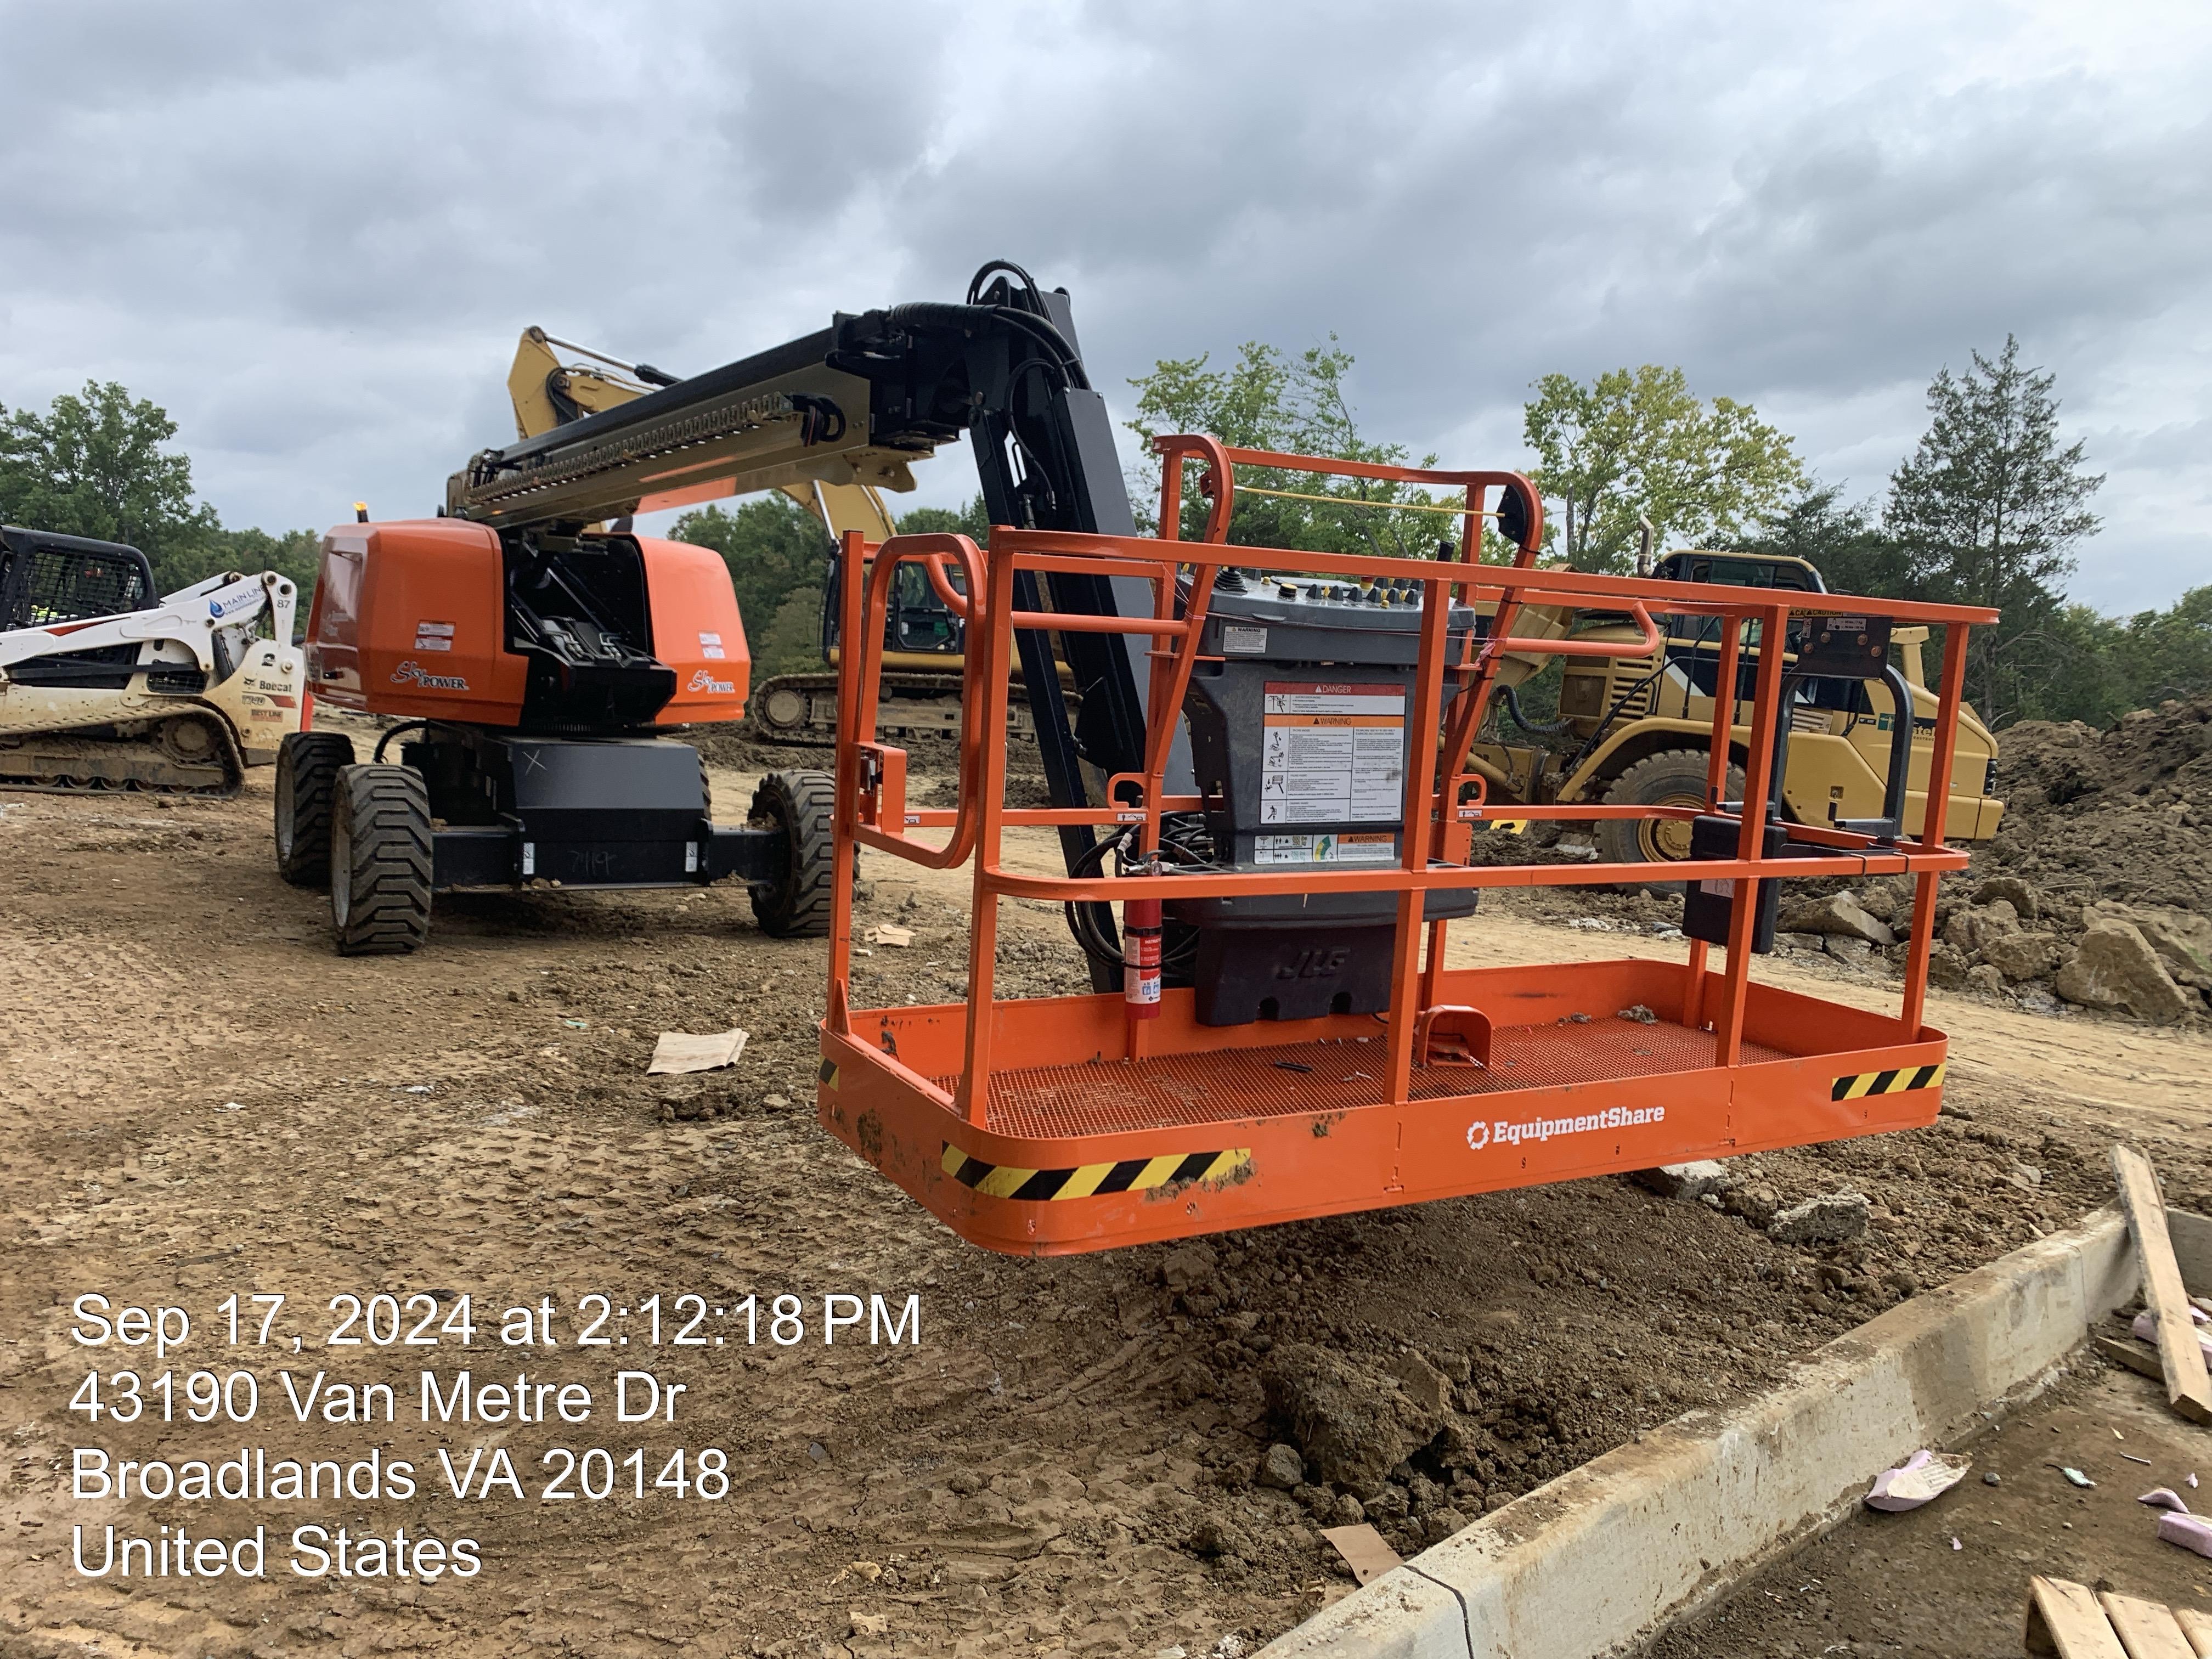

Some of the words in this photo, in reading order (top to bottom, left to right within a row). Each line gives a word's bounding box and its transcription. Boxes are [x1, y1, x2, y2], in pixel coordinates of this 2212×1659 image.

[222, 592, 246, 608] MAIN
[276, 600, 290, 608] 87
[259, 680, 292, 692] Bobcat
[1323, 685, 1352, 693] DANGER
[1912, 725, 1936, 737] stel
[1493, 1106, 1665, 1146] EquipmentShare
